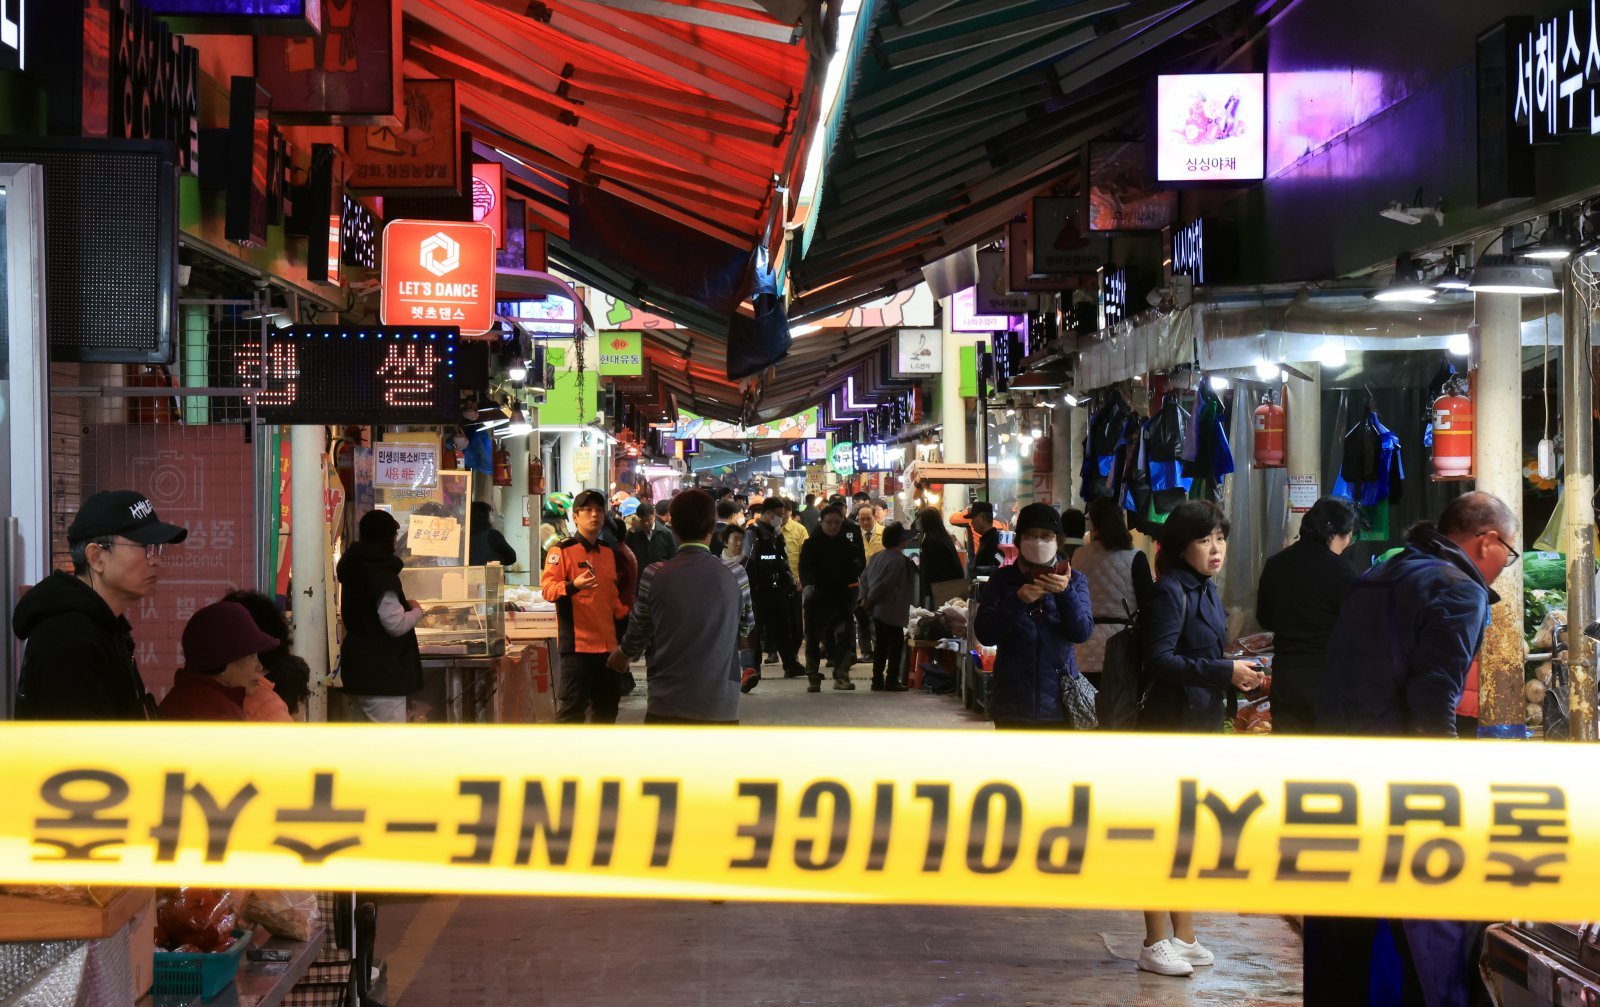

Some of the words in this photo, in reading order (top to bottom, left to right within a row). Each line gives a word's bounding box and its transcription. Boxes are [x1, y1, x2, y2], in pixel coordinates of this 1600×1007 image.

[1185, 156, 1237, 172] 싱싱야채
[399, 281, 432, 297] LET'S
[435, 283, 478, 298] DANCE
[411, 306, 466, 321] 렛츠댄스
[600, 354, 640, 365] 현대유통
[385, 467, 399, 480] 사용
[401, 467, 416, 480] 하는
